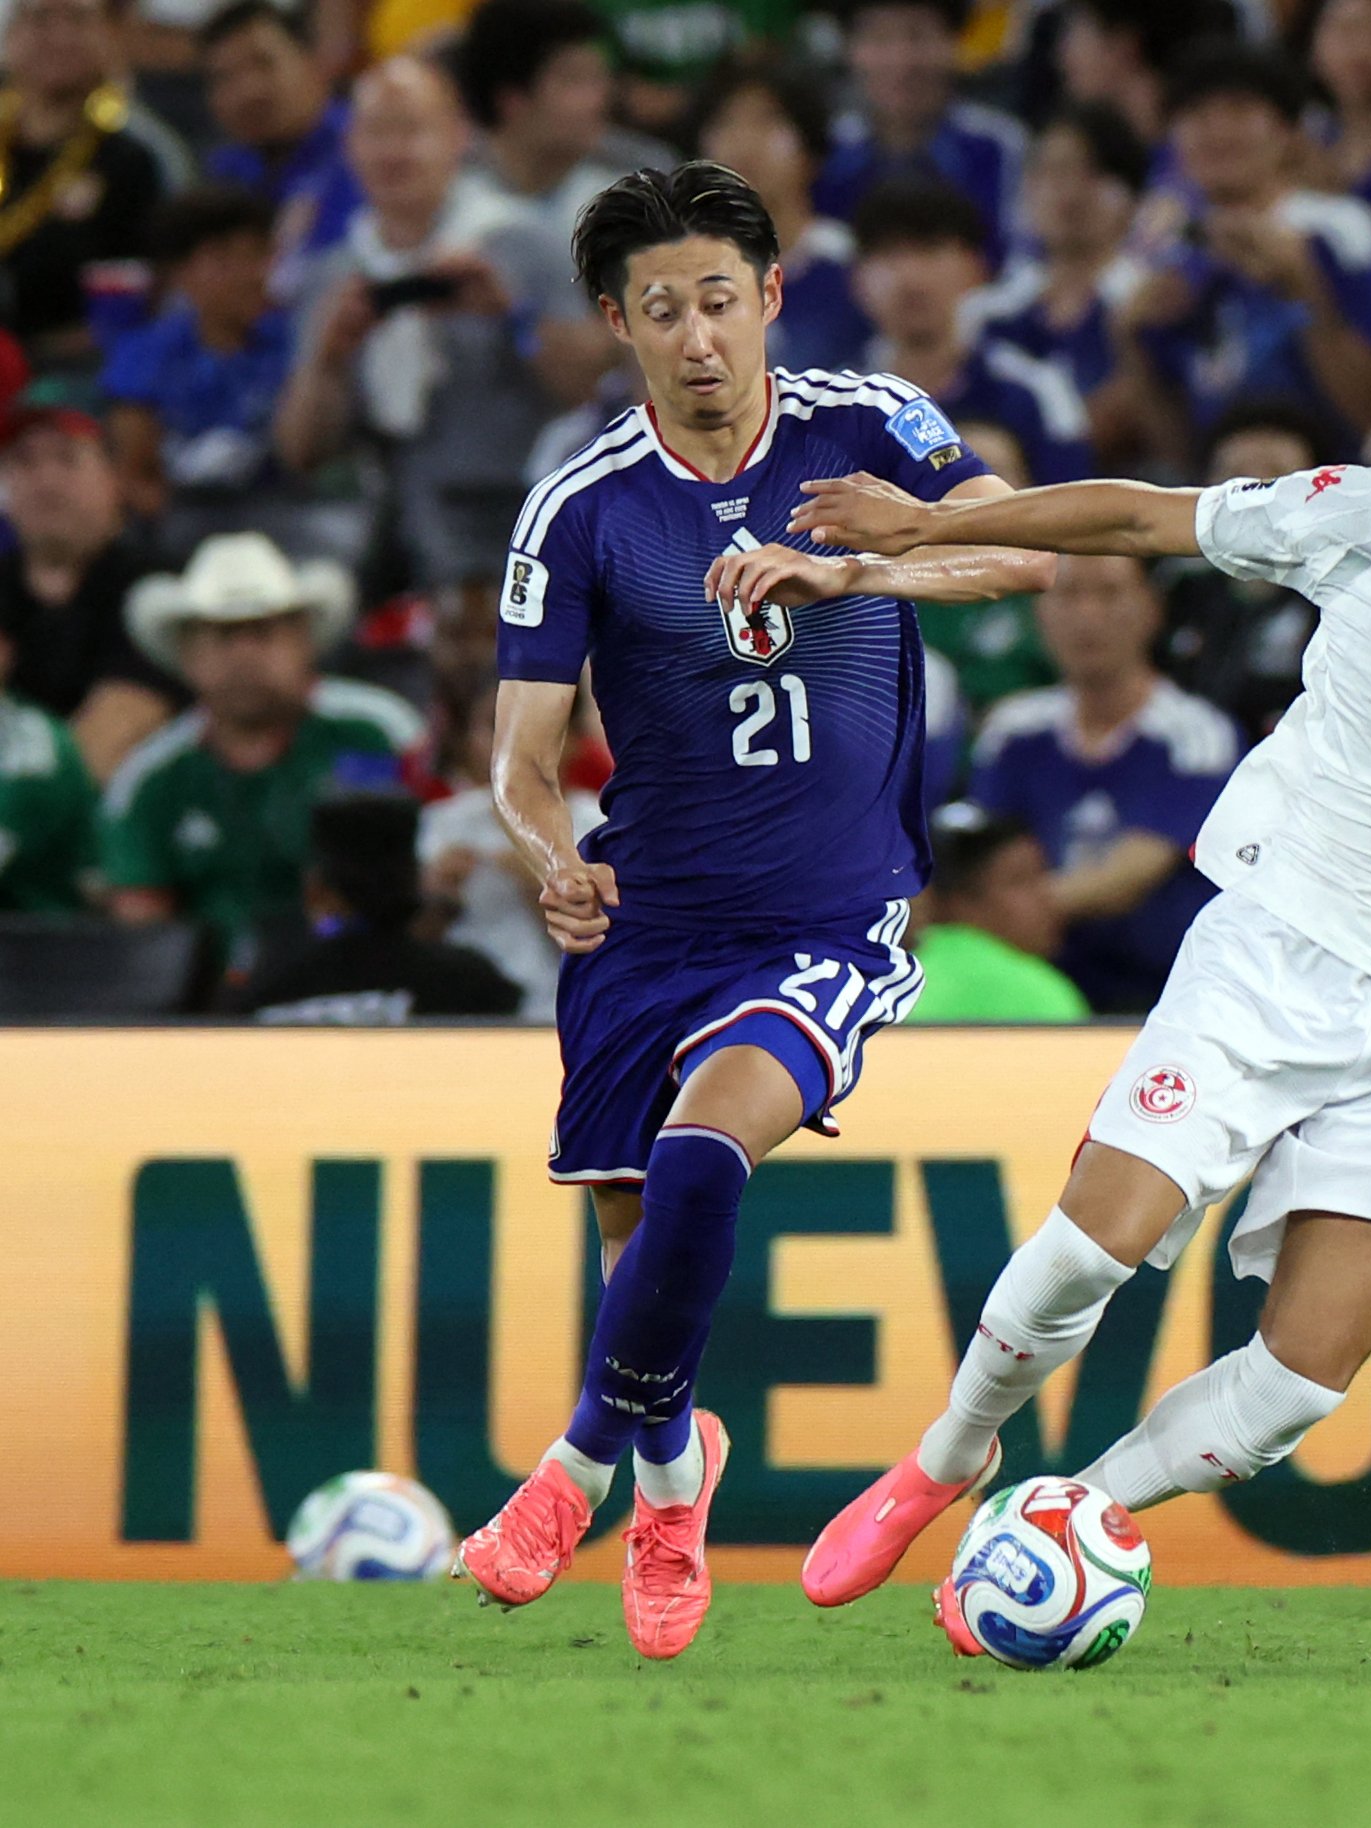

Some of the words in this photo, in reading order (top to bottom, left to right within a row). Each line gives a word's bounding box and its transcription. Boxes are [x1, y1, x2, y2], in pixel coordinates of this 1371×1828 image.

[728, 673, 812, 767] 21
[778, 952, 867, 1031] 21
[1199, 1451, 1240, 1482] FT
